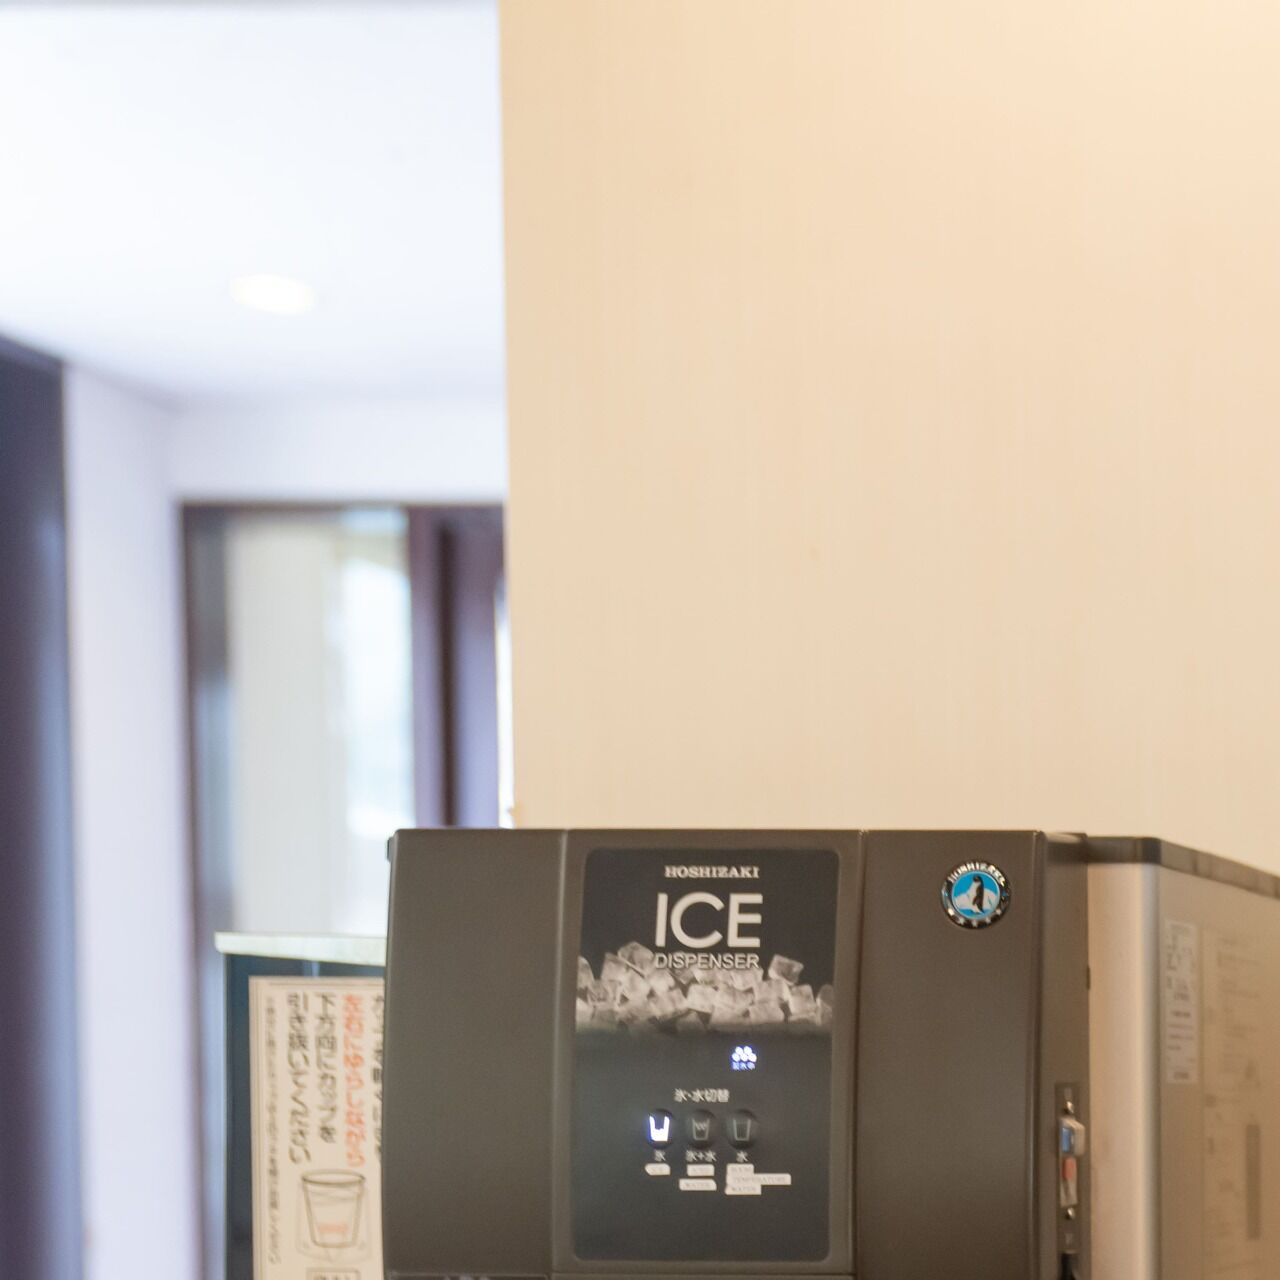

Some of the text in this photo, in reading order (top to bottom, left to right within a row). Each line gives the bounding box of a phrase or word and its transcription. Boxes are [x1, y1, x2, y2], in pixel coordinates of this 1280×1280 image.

[665, 866, 760, 879] HOSHIZAKI
[655, 892, 763, 948] ICE
[655, 953, 760, 970] DISPENSER
